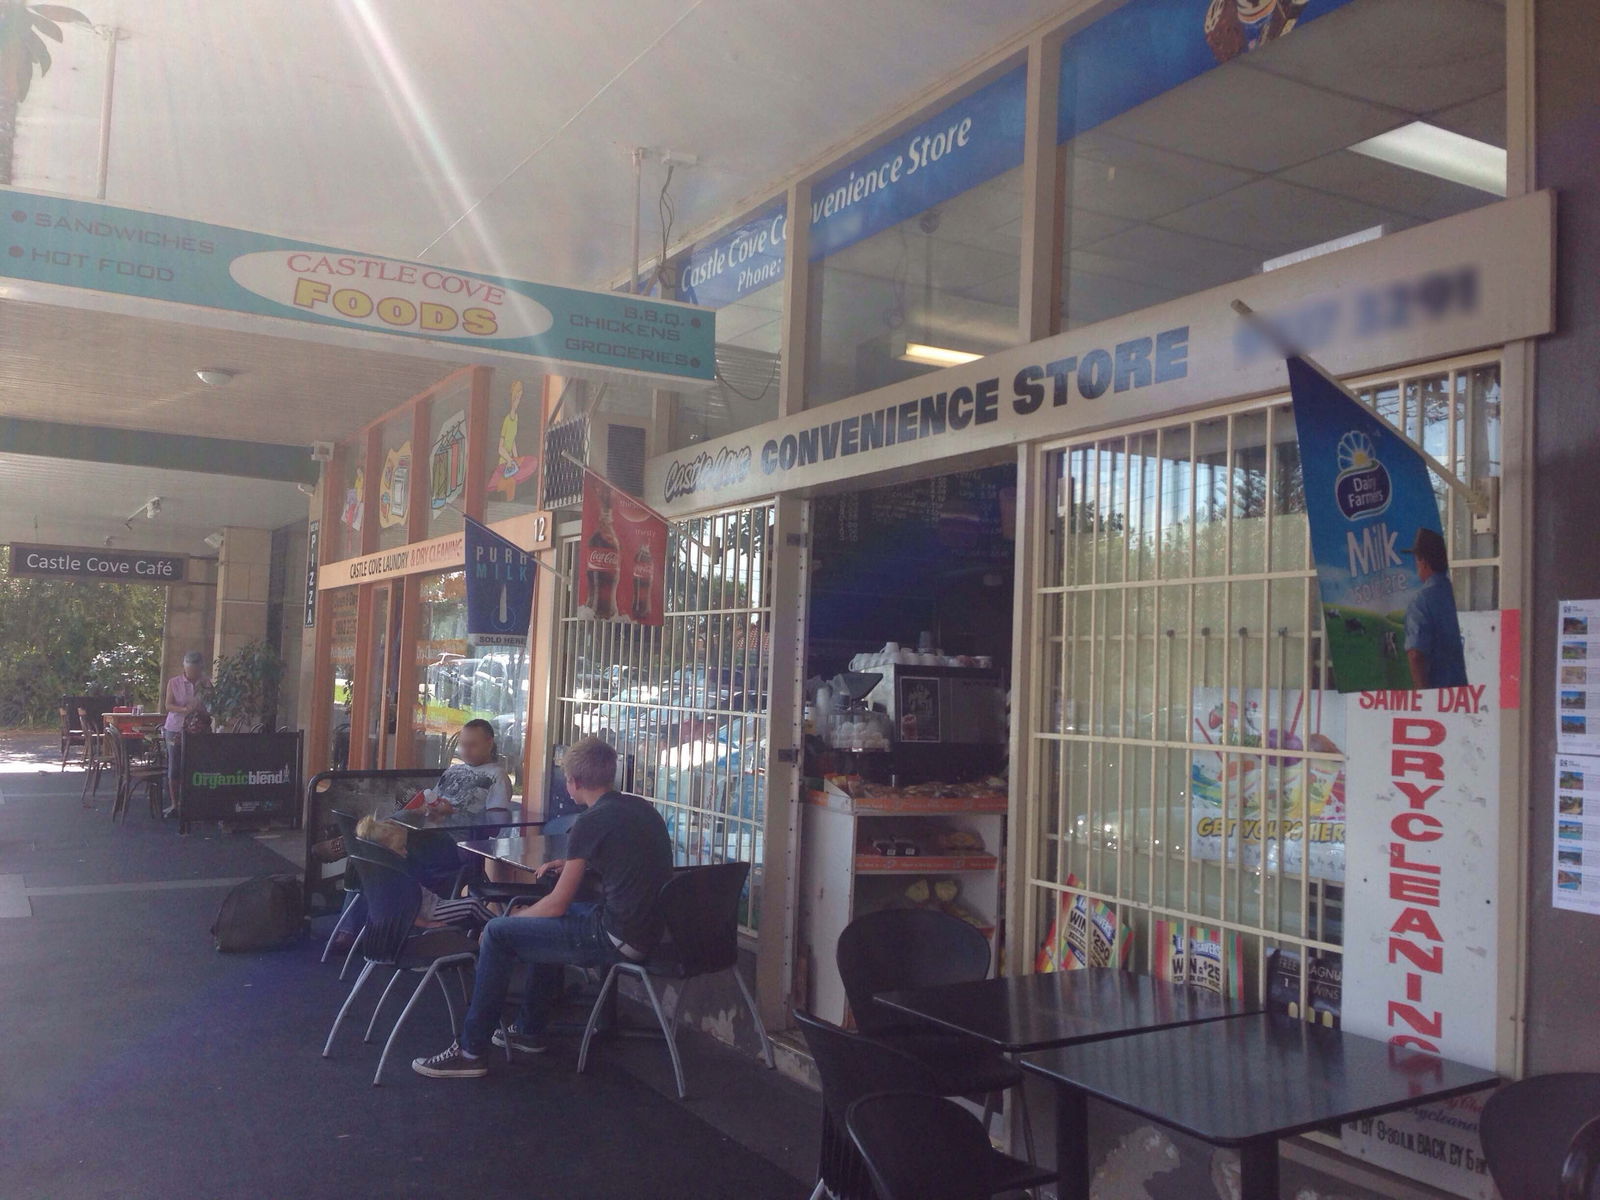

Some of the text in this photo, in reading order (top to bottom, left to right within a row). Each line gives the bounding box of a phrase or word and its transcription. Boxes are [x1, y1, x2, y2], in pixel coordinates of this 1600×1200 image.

[681, 254, 725, 291] Castle
[728, 228, 767, 266] Cove
[907, 117, 972, 175] Store
[35, 213, 215, 254] SANDWICHES
[32, 247, 175, 282] HOT FOOD
[738, 259, 782, 293] Phone:
[287, 254, 506, 305] CASTLE COVE
[293, 277, 498, 336] FOODS
[569, 314, 681, 342] CHICKENS
[565, 338, 689, 367] GROCERIES
[760, 377, 999, 475] CONVENIENCE
[1012, 326, 1190, 415] STORE
[534, 517, 546, 542] 12
[1347, 522, 1402, 577] Milk
[27, 553, 173, 576] Castle Cove Café
[350, 562, 367, 578] CASTLE
[368, 558, 382, 575] COVE
[383, 551, 409, 572] LAUNDRY
[476, 563, 527, 580] MILK
[479, 636, 501, 644] SOLD
[1359, 685, 1486, 713] SAME DAY
[1197, 817, 1236, 838] GET
[1310, 822, 1345, 843] HER
[1172, 958, 1197, 975] WN
[1417, 1132, 1448, 1164] BACK
[1449, 1143, 1465, 1170] BY
